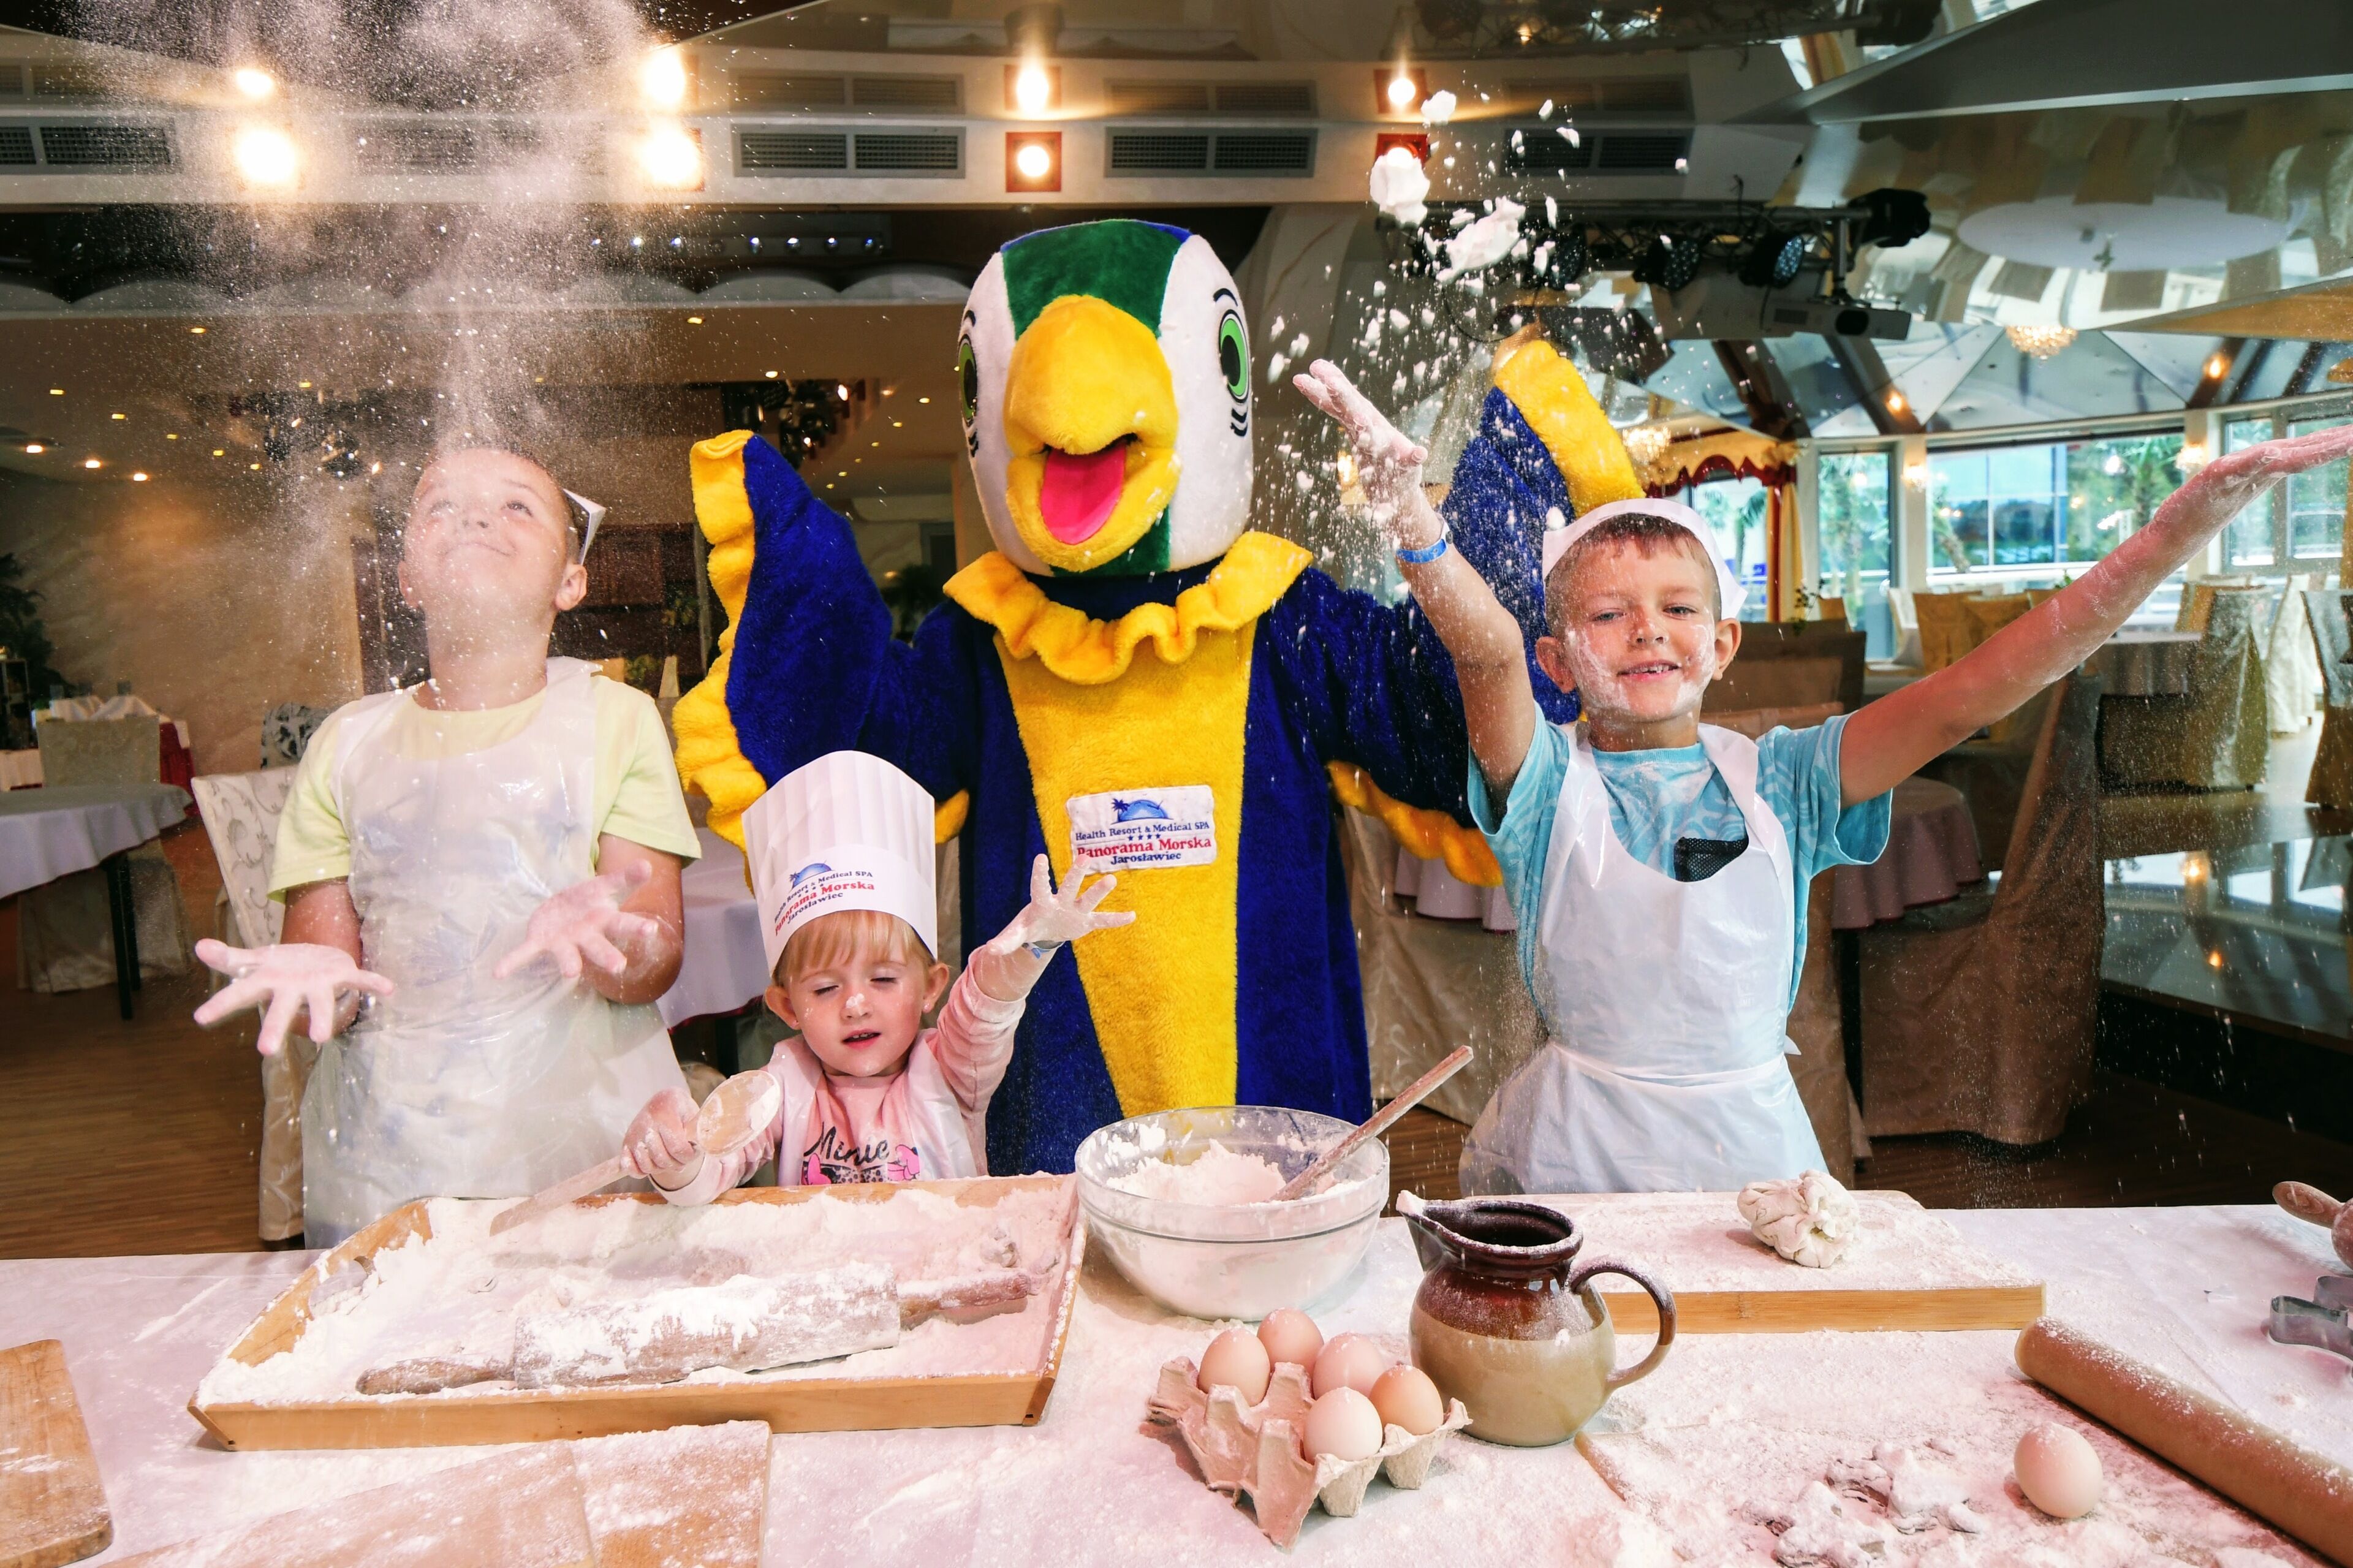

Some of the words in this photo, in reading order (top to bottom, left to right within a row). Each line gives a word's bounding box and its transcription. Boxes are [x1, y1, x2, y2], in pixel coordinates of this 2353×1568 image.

[1075, 830, 1106, 841] Health
[1109, 825, 1142, 836] Resort
[1153, 823, 1192, 832] Medical
[1194, 821, 1210, 830] SPA
[1159, 837, 1211, 850] Morska
[787, 884, 808, 903] Resort
[818, 871, 852, 884] Medical
[821, 881, 874, 895] Morska
